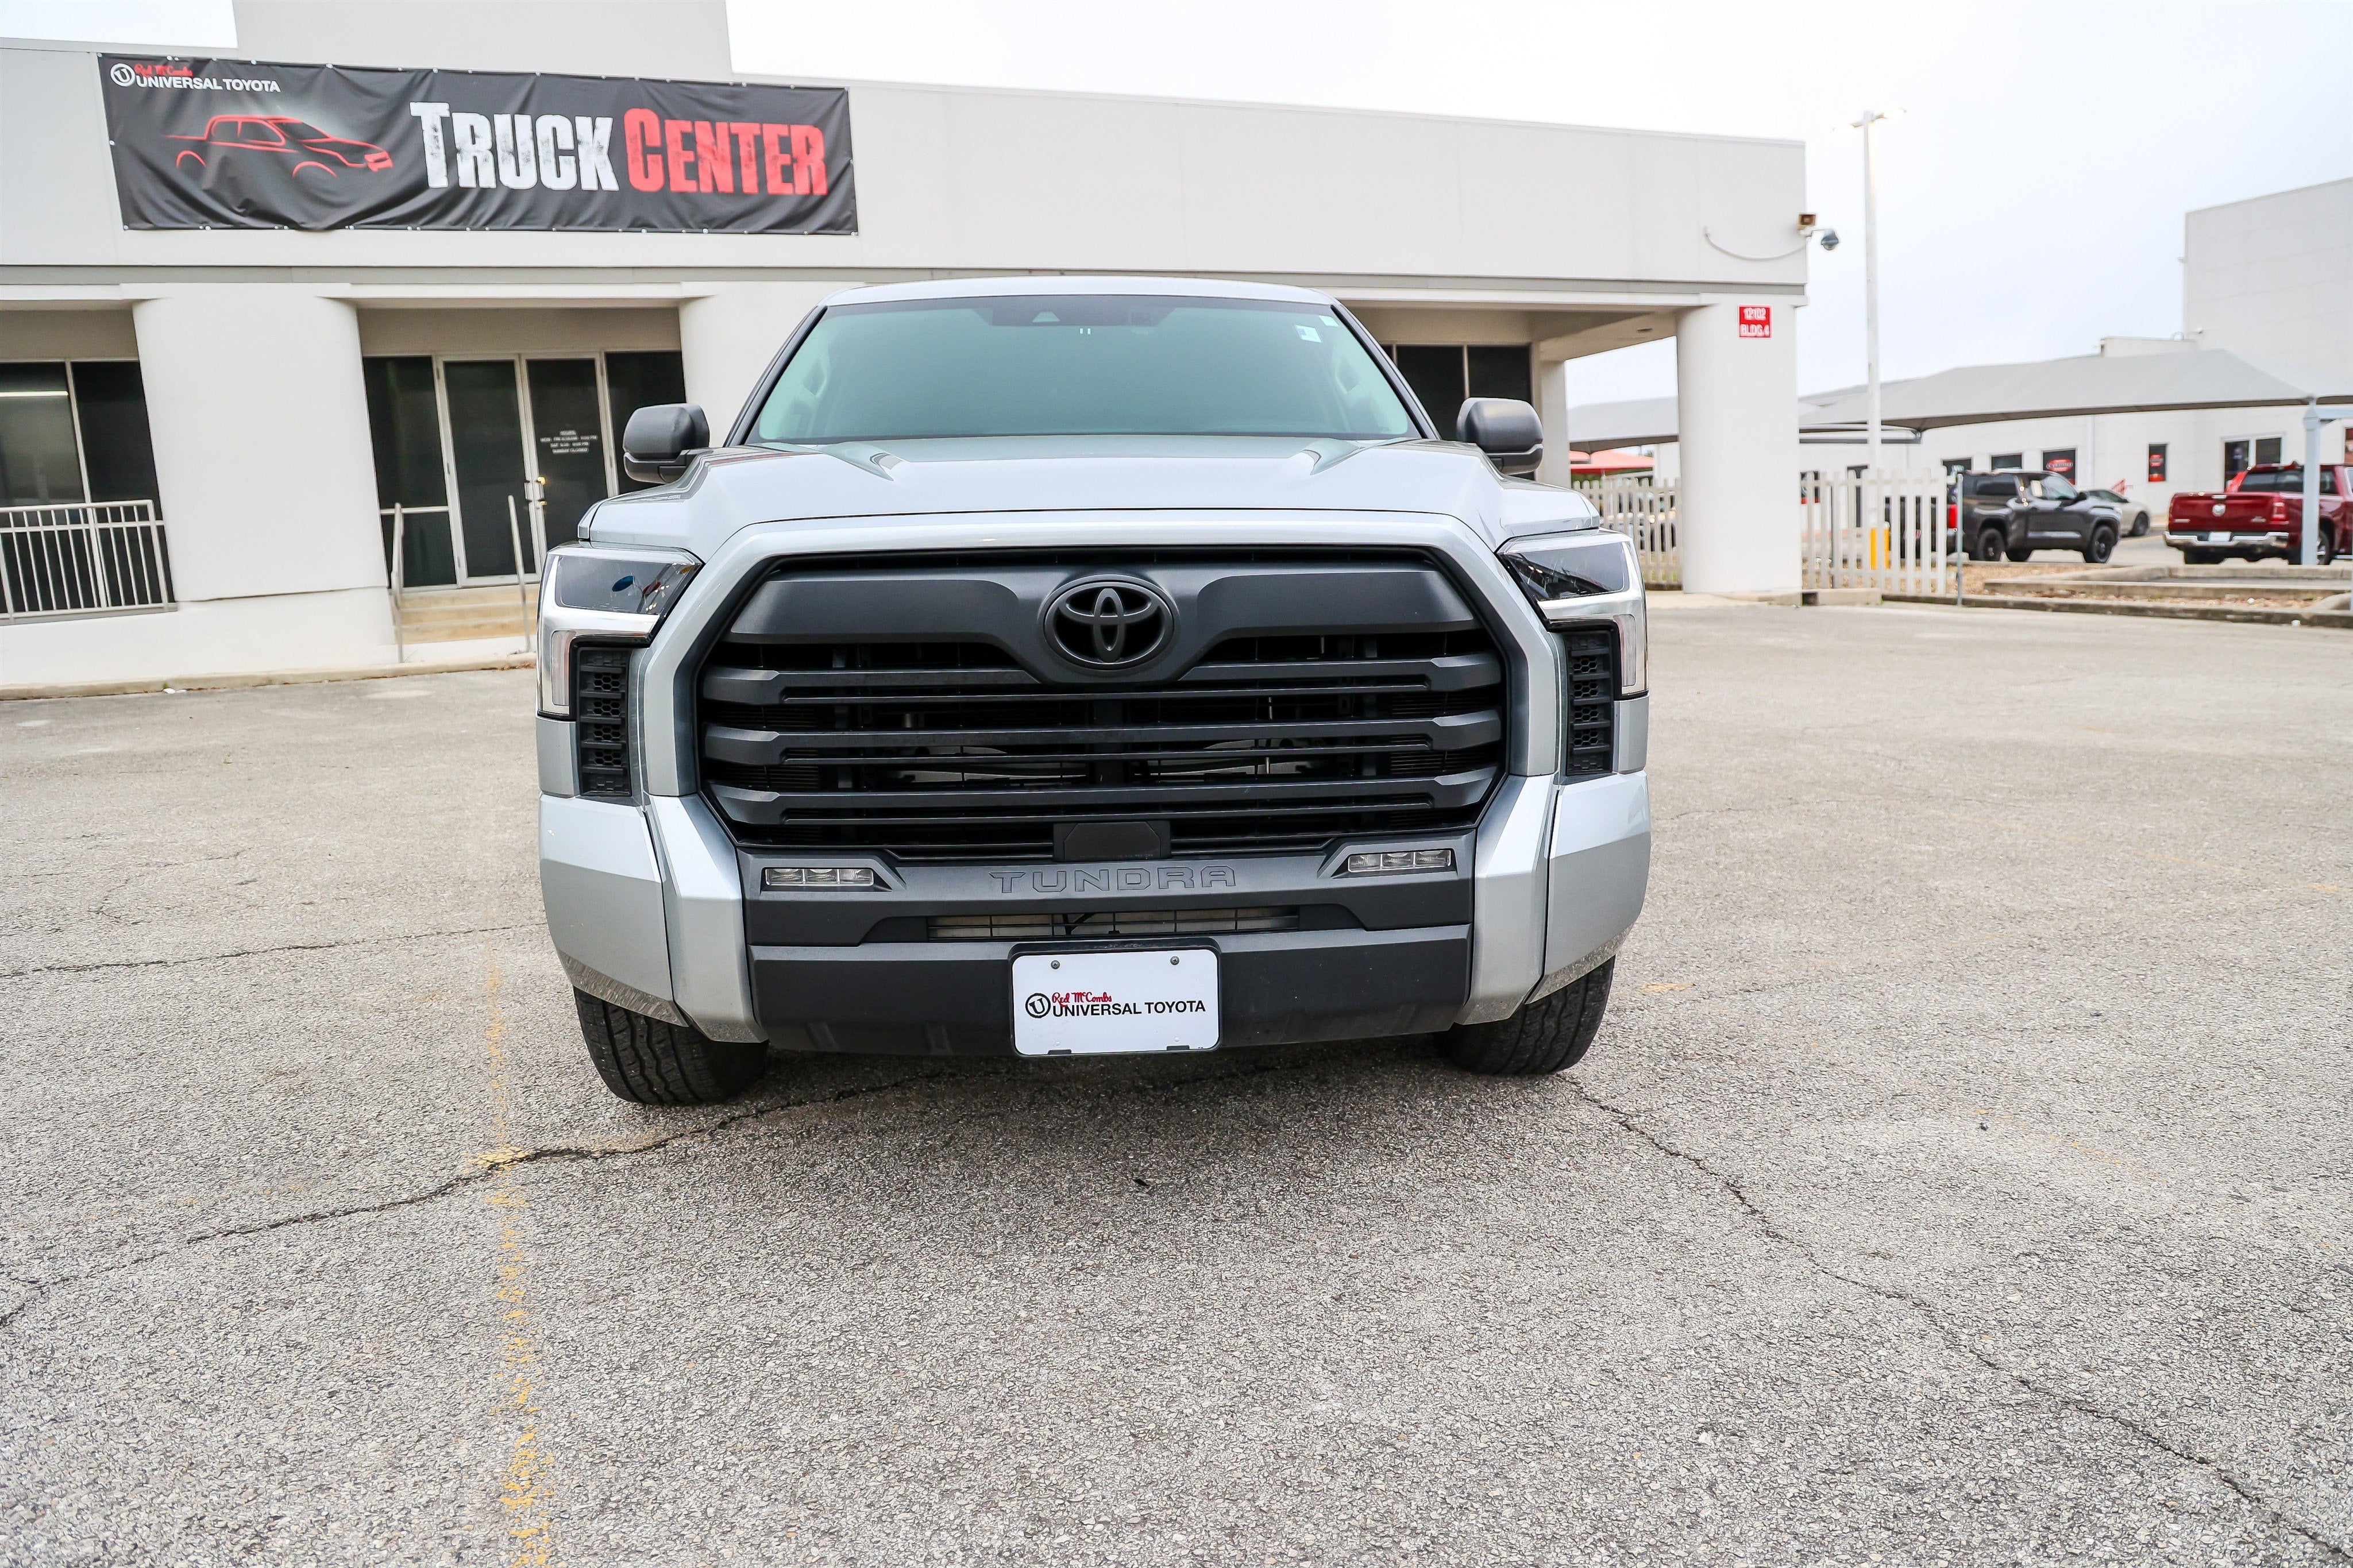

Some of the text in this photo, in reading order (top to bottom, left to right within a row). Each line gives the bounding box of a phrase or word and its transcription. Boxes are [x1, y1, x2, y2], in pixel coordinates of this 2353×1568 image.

[136, 75, 281, 92] UNIVERSAL TOYOTA
[410, 102, 829, 196] TRUCK CENTER
[988, 865, 1236, 894] TUNDRA
[1051, 991, 1113, 1007] Red McCombs
[1052, 1000, 1206, 1017] UNIVERSAL TOYOTA
